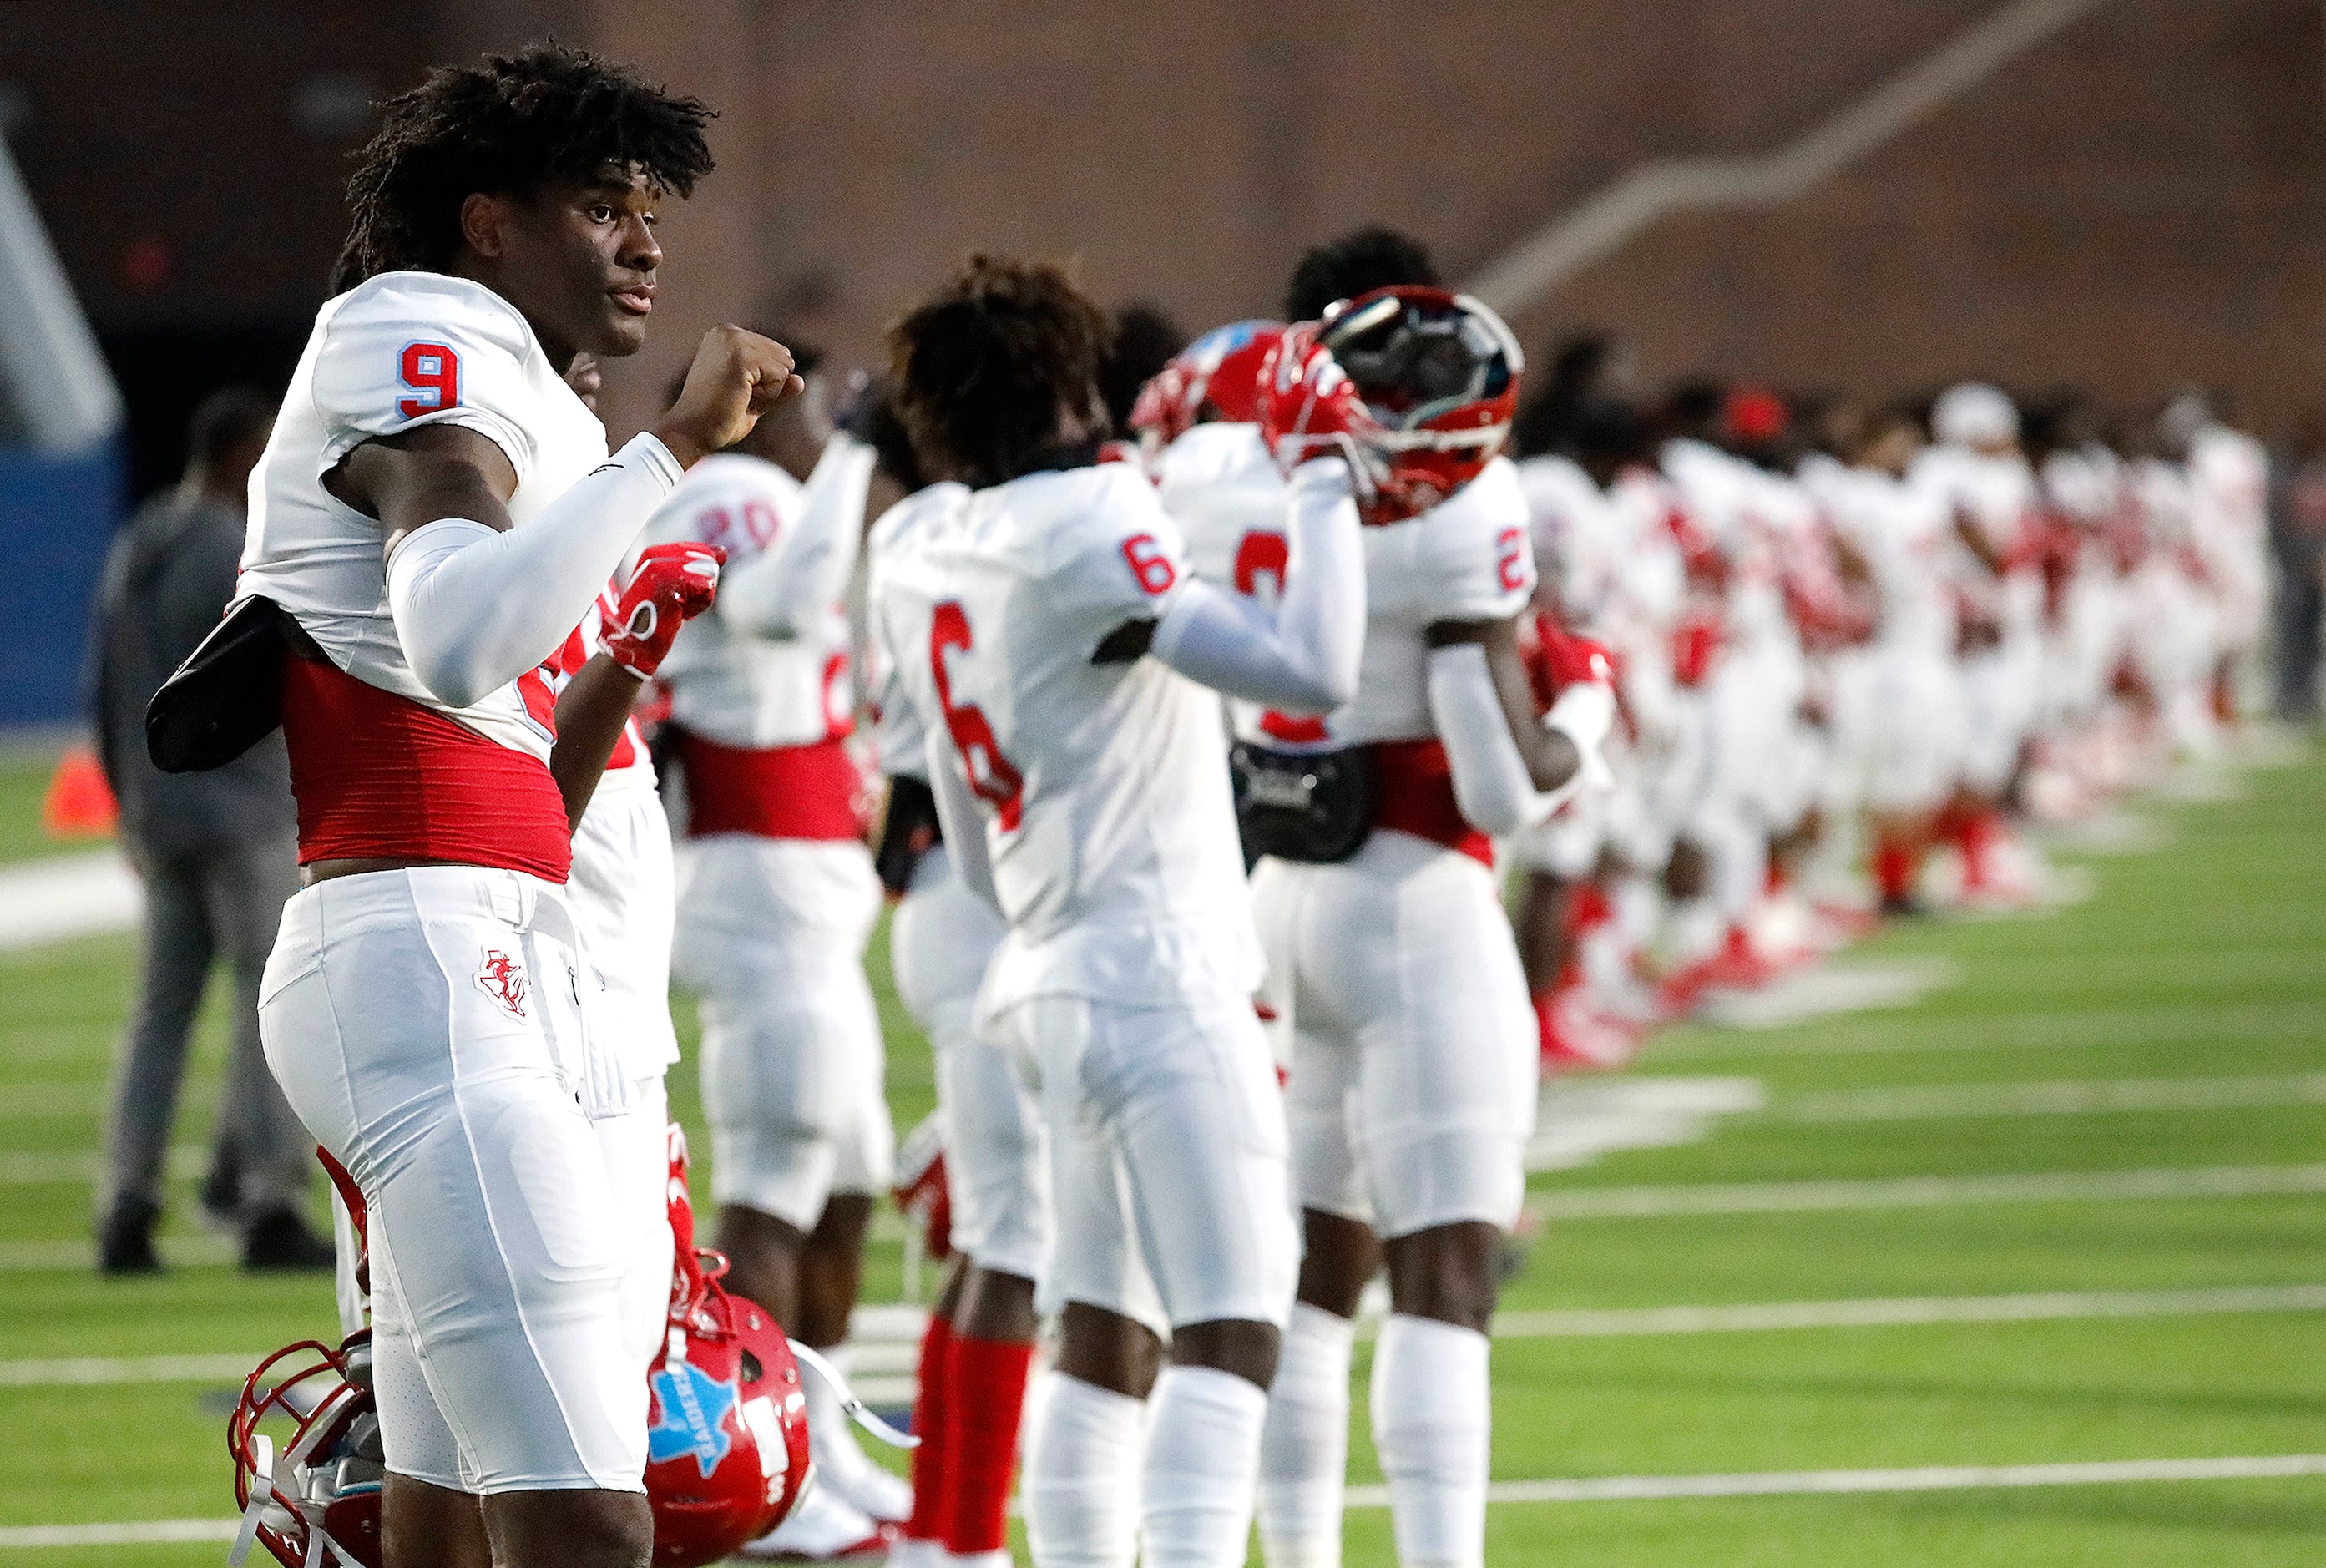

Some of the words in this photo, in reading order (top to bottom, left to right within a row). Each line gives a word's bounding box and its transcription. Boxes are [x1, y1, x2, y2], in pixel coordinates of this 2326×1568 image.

[395, 339, 463, 422] 9
[1120, 533, 1176, 596] 6
[929, 599, 1025, 833] 6
